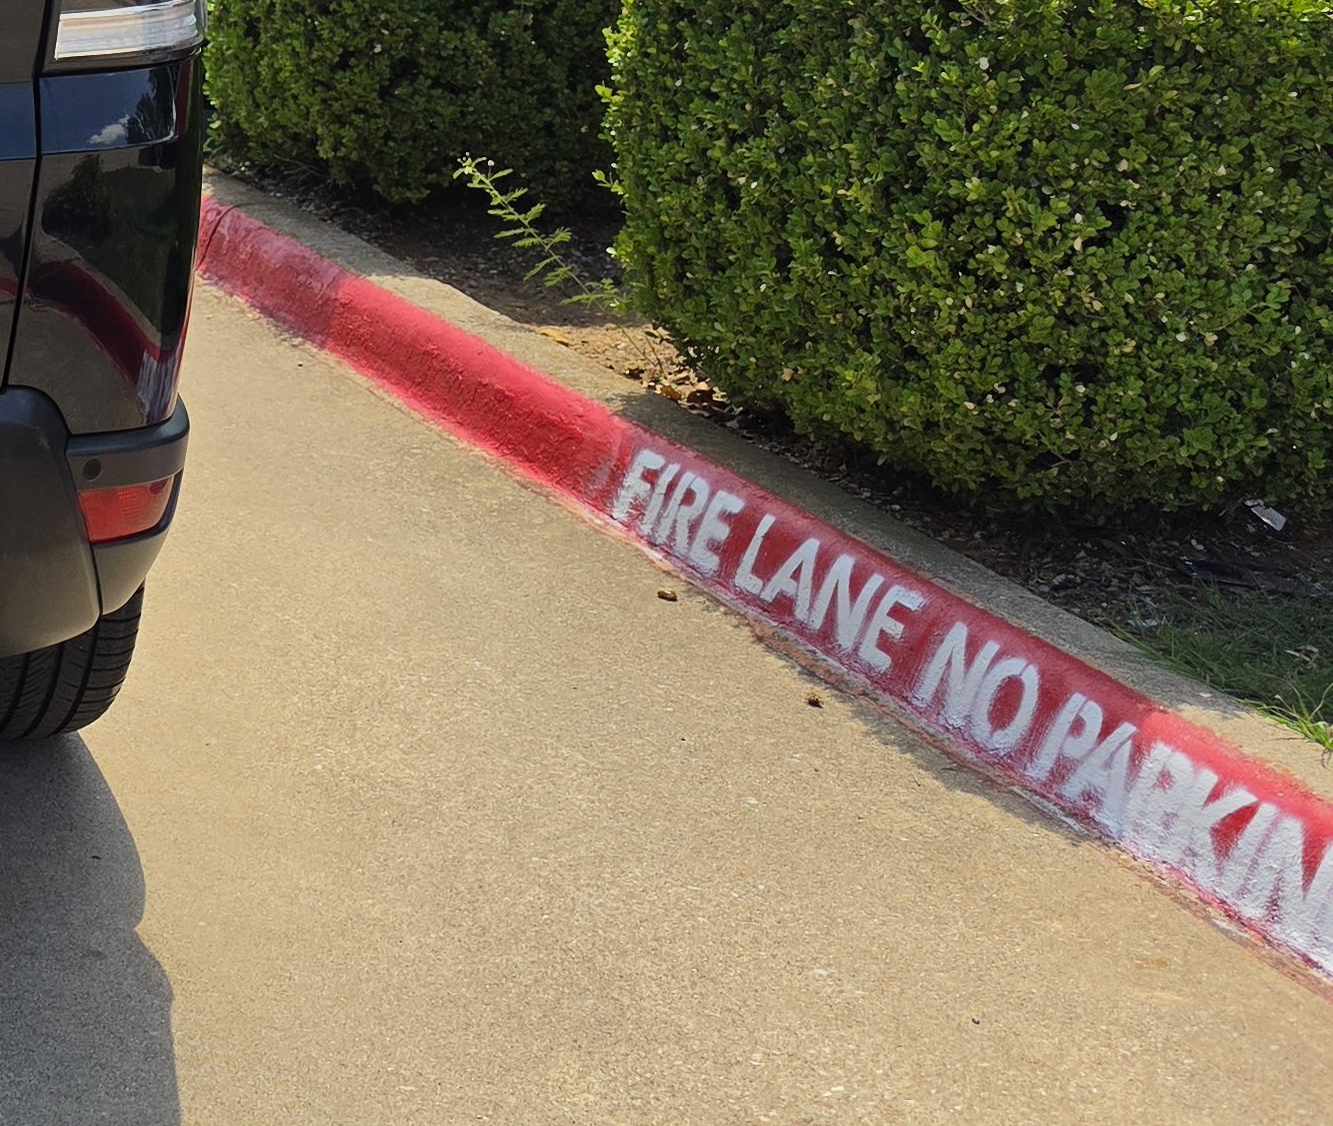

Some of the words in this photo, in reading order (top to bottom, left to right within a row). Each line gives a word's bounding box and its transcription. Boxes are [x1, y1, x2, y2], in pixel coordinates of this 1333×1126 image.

[612, 449, 745, 574] FIRE
[734, 514, 926, 674] LANE
[911, 621, 1039, 757] NO
